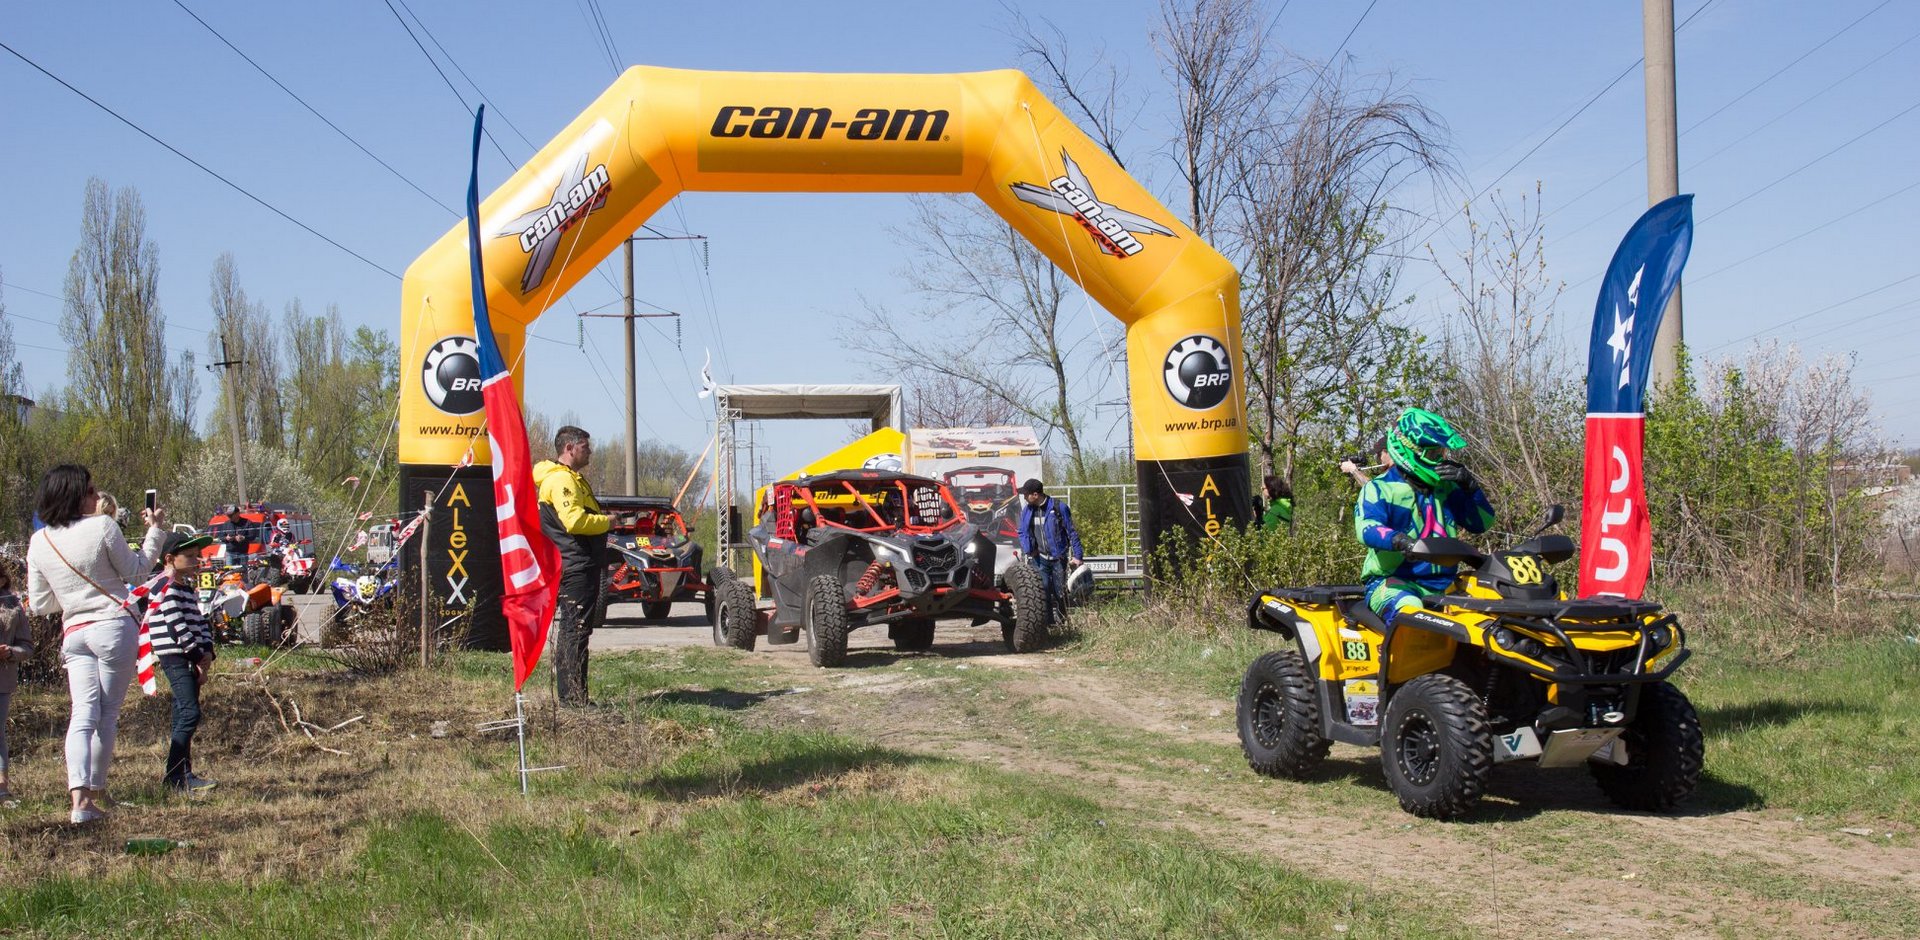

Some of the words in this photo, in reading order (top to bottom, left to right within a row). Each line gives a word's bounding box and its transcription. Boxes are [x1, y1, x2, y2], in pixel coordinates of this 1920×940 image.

[710, 106, 949, 141] can-am
[519, 163, 611, 254] can-am
[1050, 175, 1144, 256] can-am
[451, 378, 484, 391] BR
[1193, 373, 1230, 388] BRP
[1165, 417, 1237, 433] www.brp.ua
[1507, 555, 1542, 585] 88
[1346, 642, 1367, 660] 88
